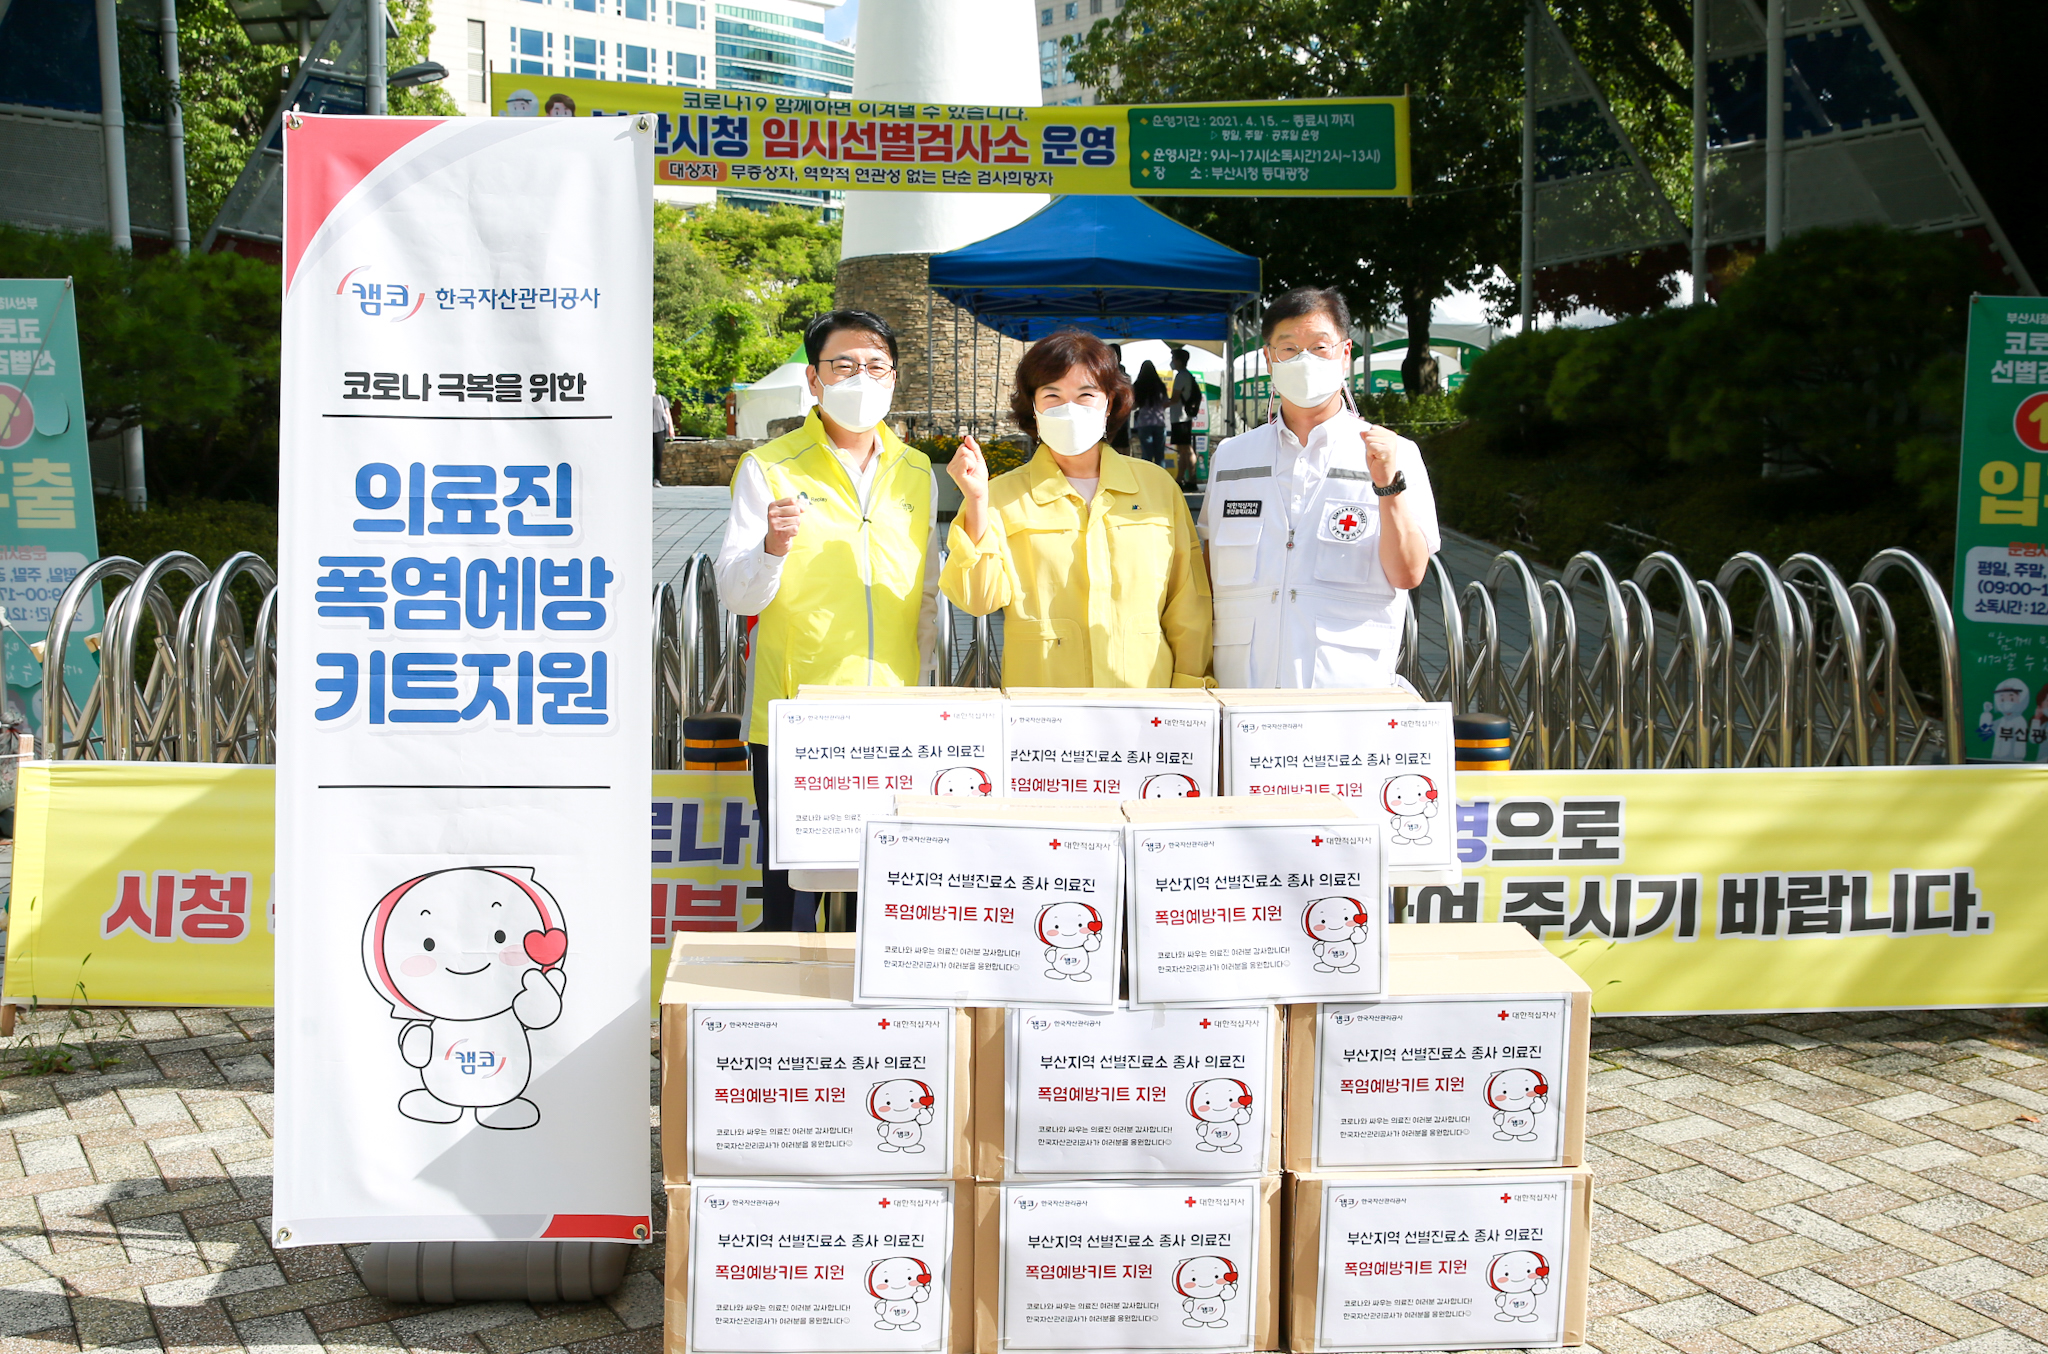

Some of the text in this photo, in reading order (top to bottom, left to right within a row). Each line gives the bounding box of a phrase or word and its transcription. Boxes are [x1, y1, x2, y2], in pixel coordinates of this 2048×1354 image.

[683, 92, 766, 112] 코로나19
[776, 97, 851, 117] 함께하면
[922, 105, 941, 119] 수
[947, 106, 1029, 121] 있습니다.
[1331, 113, 1355, 127] 까지
[763, 118, 1029, 164] 임시선별검사소
[1041, 126, 1115, 166] 운영
[1301, 129, 1320, 142] 운영
[669, 162, 1053, 187] 대상자 무증상자, 역학적 연관성 없는 단순 검사희망자
[1211, 166, 1259, 182] 부산시청
[1262, 166, 1310, 182] 등대광장
[352, 283, 600, 316] 캠코 한국자산관리공사
[343, 371, 588, 402] 코로나 극복을 위한
[353, 462, 574, 537] 의료진
[1977, 561, 2010, 578] 평일,
[314, 556, 614, 631] 폭염예방
[314, 650, 610, 726] 키트지원
[796, 745, 984, 759] 부산지역 선별진료소 종사 의료진
[1061, 750, 1122, 762] 선별진료소
[1127, 751, 1151, 764] 종사
[1156, 752, 1192, 765] 의료진
[1250, 753, 1430, 769] 부산지역 선별진료소 종사 의료진
[795, 775, 912, 790] 폭염예방키트 지원
[1094, 780, 1120, 793] 지원
[1334, 783, 1362, 797] 지원
[1063, 841, 1111, 851] 대한적십자사
[1325, 836, 1372, 846] 대한적십자사
[888, 872, 1094, 892] 부산지역 선별진료소 종사 의료진
[1156, 873, 1360, 892] 부산지역 선별진료소 종사 의료진
[106, 875, 247, 939] 시청
[885, 904, 1013, 923] 폭염예방키트 지원
[1503, 879, 1697, 939] 주시기
[1720, 872, 1990, 935] 바랍니다.
[1156, 906, 1281, 925] 폭염예방키트 지원
[893, 1020, 940, 1029] 대한적십자사
[1213, 1019, 1260, 1029] 대한적십자사
[1041, 1055, 1244, 1069] 부산지역 선별진료소 종사 의료진
[1343, 1046, 1541, 1062] 부산지역 선별진료소 종사 의료진
[455, 1051, 496, 1076] 캠코
[717, 1056, 925, 1070] 부산지역 선별진료소 종사 의료진
[1341, 1077, 1464, 1094] 폭염예방키트 지원
[715, 1088, 845, 1103] 폭염예방키트 지원
[1038, 1087, 1165, 1102] 폭염예방키트 지원
[1513, 1193, 1558, 1202] 대한적십자사
[1028, 1234, 1230, 1248] 부산지역 선별진료소 종사 의료진
[1348, 1228, 1542, 1245] 부산지역 선별진료소 종사 의료진
[1026, 1264, 1152, 1279] 폭염예방키트 지원
[1345, 1260, 1466, 1276] 폭염예방키트 지원
